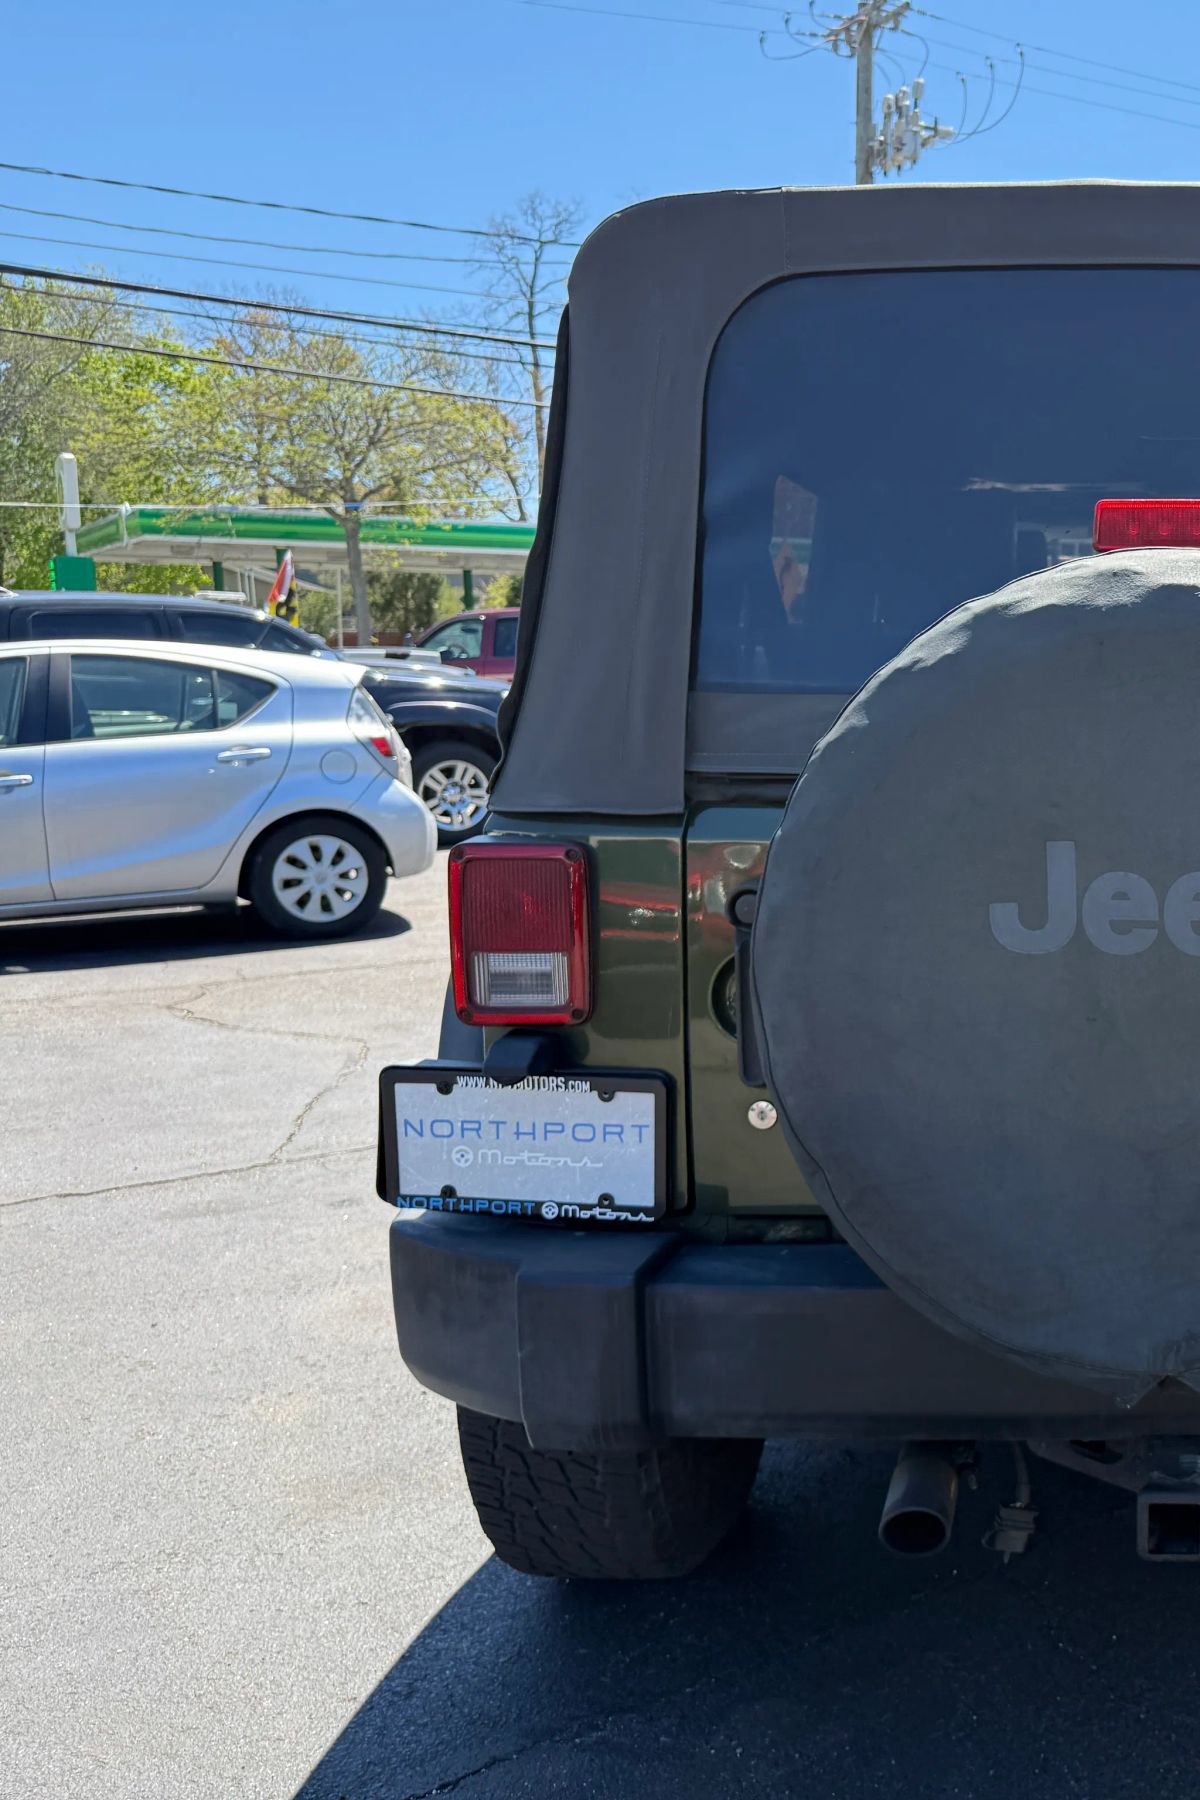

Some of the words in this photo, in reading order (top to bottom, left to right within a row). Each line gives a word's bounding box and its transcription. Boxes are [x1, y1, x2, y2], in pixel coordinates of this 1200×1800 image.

[403, 1119, 650, 1143] NORTHPORT
[479, 1149, 603, 1167] Motors
[396, 1196, 535, 1217] NORTHPORT
[561, 1204, 654, 1222] Motors
